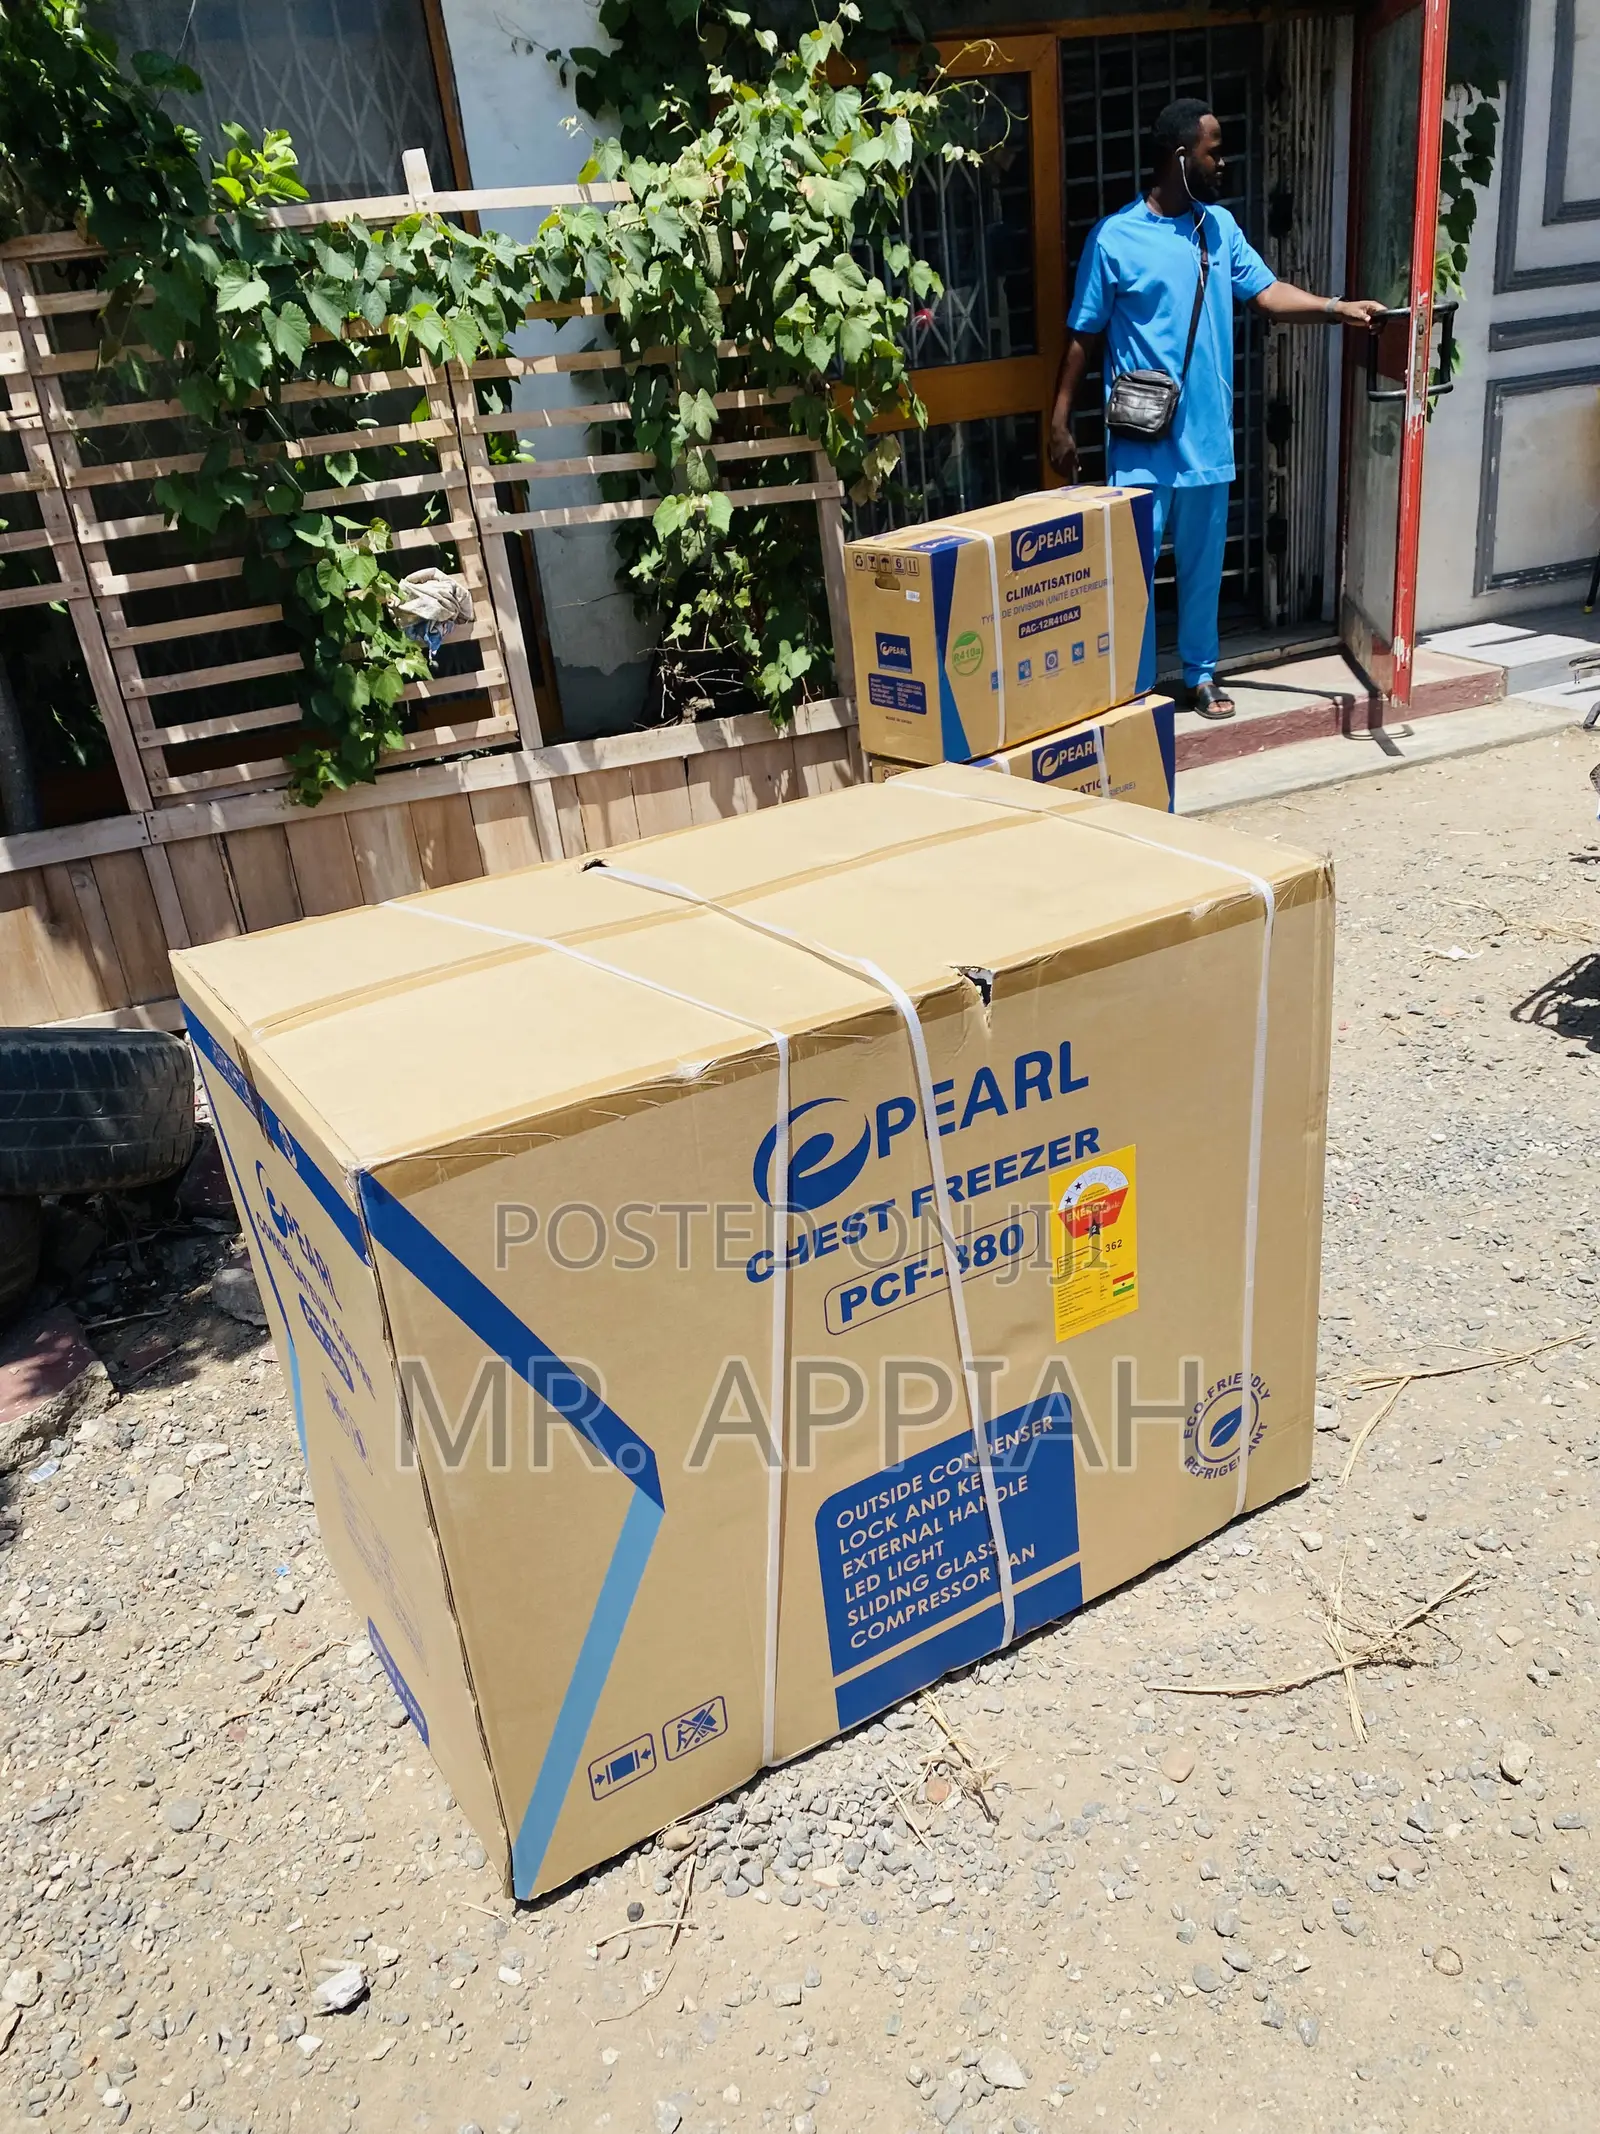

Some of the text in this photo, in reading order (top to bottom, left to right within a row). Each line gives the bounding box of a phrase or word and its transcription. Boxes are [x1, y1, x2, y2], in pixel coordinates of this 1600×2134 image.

[1038, 525, 1080, 551] PEARL
[1001, 610, 1012, 619] DE
[1013, 600, 1045, 616] DIVISION
[1006, 567, 1091, 603] CLIMATISATION
[876, 1041, 1089, 1159] PEARL
[745, 1127, 1101, 1283] CHEST FREEZER
[281, 1202, 343, 1313] PEARL
[1105, 1239, 1123, 1253] 362
[1183, 1372, 1271, 1439] ECO-FRIEDLY
[1184, 1422, 1268, 1480] REFRIGEANT
[836, 1474, 923, 1529] OUTSIDE
[839, 1472, 981, 1555] LOCK AND KE
[842, 1517, 944, 1579] EXTERNAL
[845, 1540, 945, 1604] LED LIGHT
[847, 1538, 998, 1627] SLIDING GLASS
[850, 1543, 1036, 1649] COMPRESSOR AN
